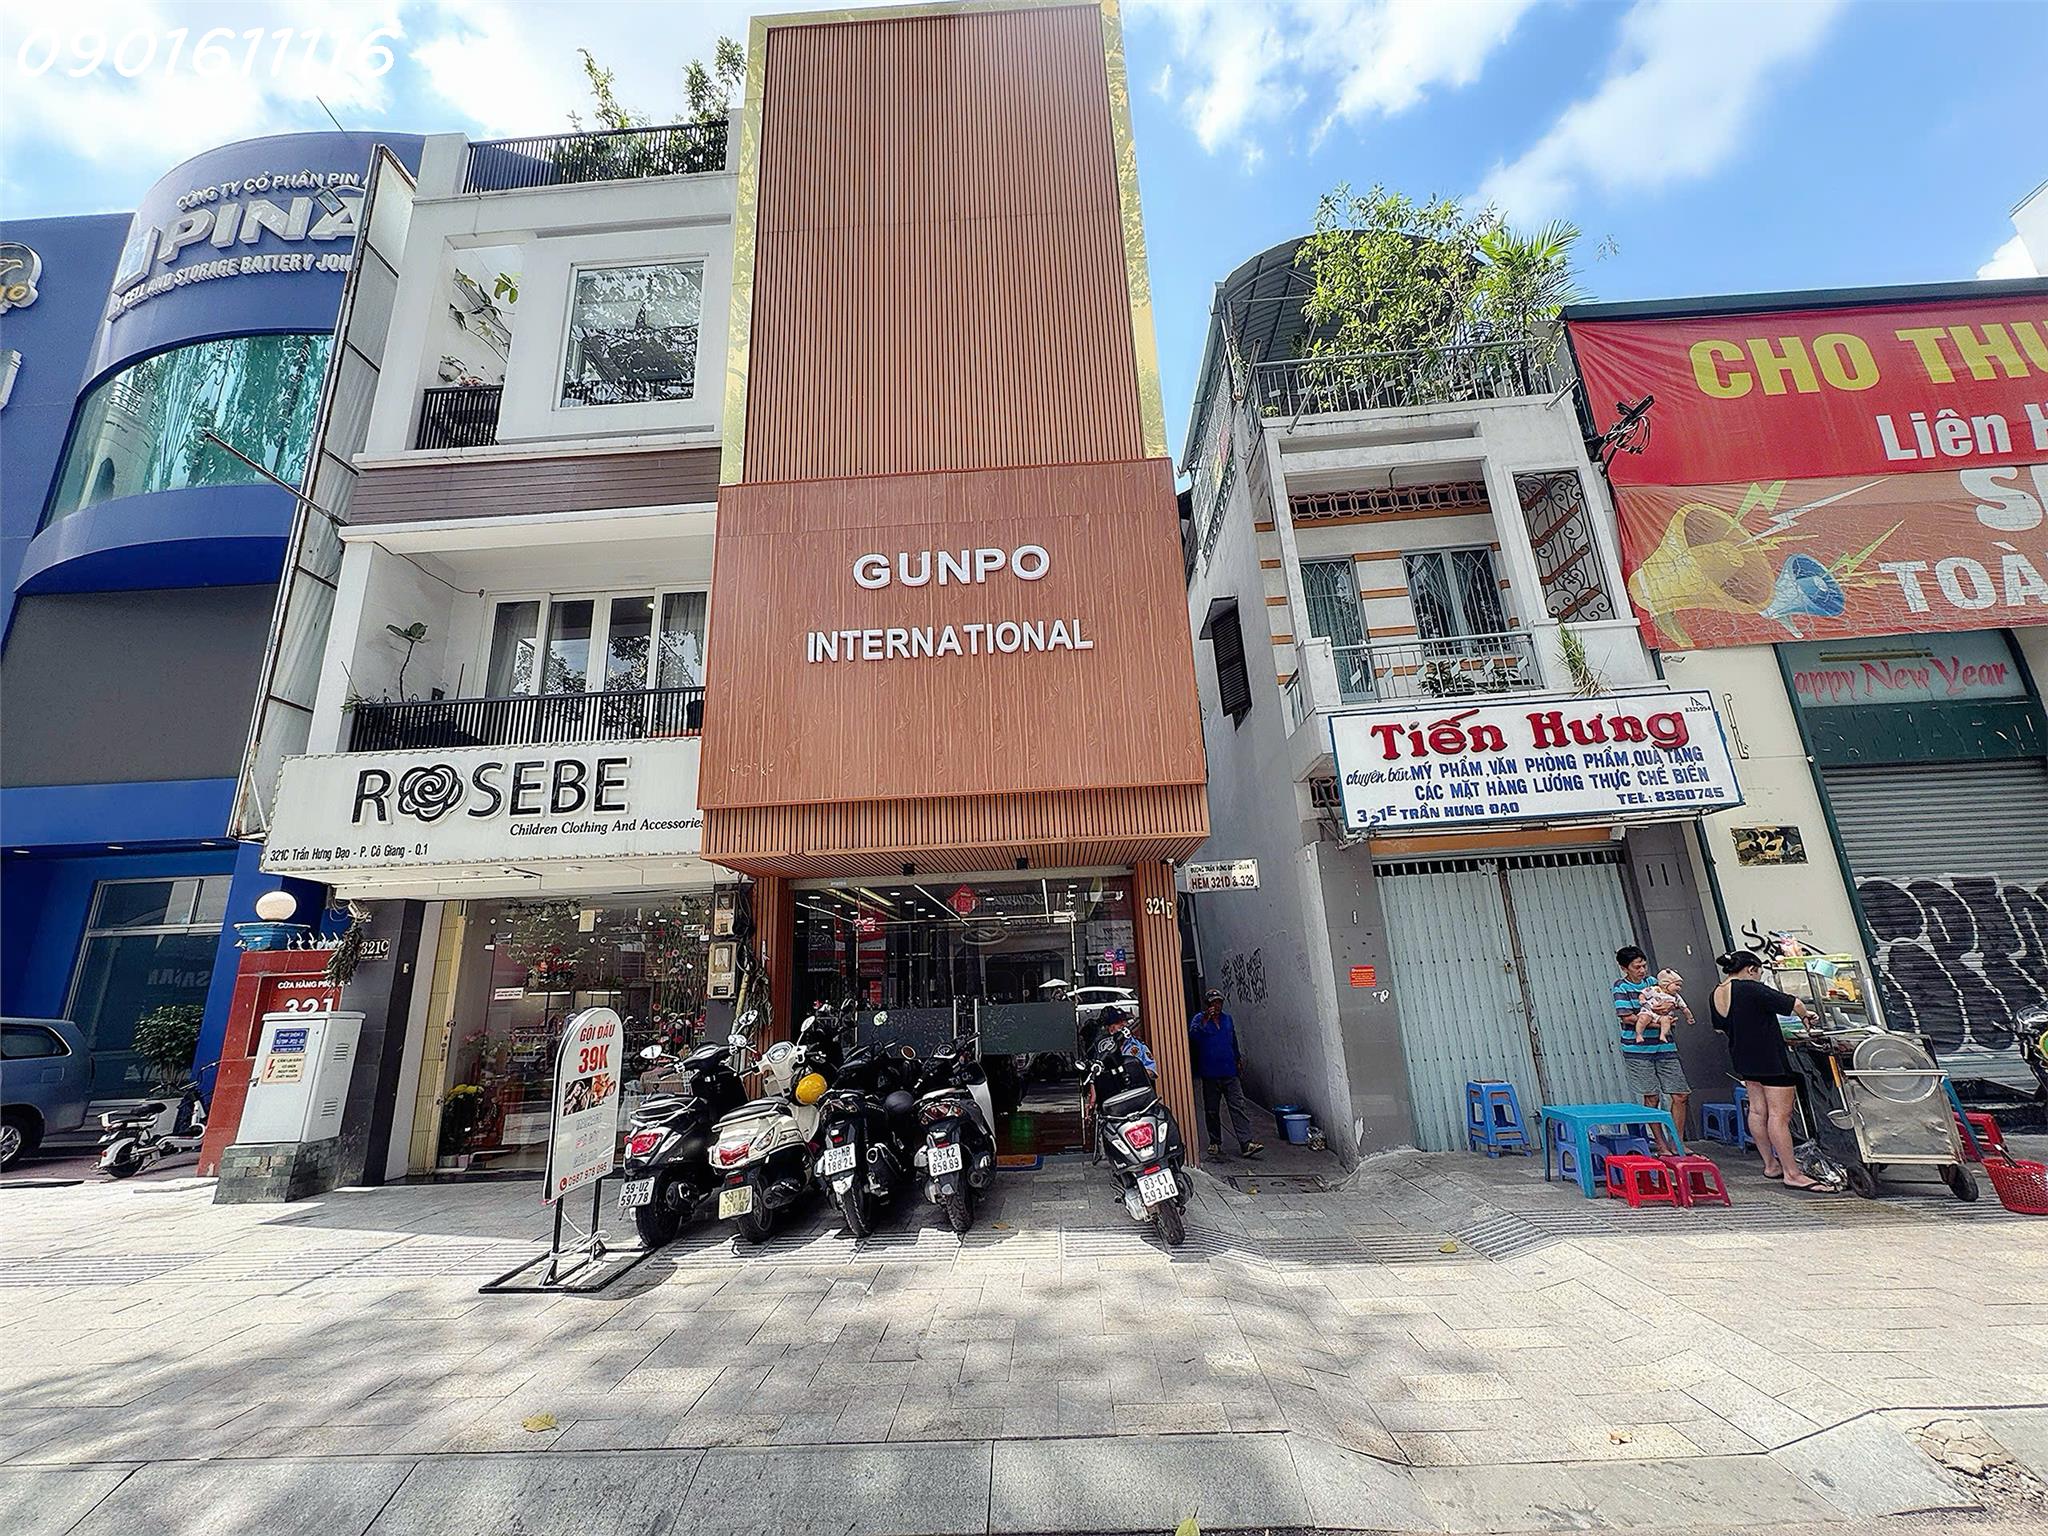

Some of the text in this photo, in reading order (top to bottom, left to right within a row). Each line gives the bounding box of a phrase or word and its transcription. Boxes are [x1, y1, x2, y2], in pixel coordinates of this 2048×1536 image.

[220, 180, 242, 198] TY
[243, 171, 273, 192] CỔ
[327, 172, 359, 186] PIN
[174, 258, 241, 286] STORAGE
[239, 253, 316, 275] BATTERY
[1688, 331, 1881, 399] CHO
[1875, 408, 2013, 461] Liên
[852, 544, 1051, 590] GUNPO
[807, 618, 1094, 663] INTERNATIONAL
[1860, 660, 1930, 698] New
[1930, 655, 2010, 696] Year
[1370, 708, 1690, 761] Tiến Hưng
[1346, 769, 1387, 787] chuyên
[1526, 751, 1576, 774] PHÒNG
[1414, 781, 1444, 801] CÁC
[1450, 779, 1480, 800] MẶT
[1486, 775, 1528, 796] HÀNG
[1589, 769, 1631, 791] THỰC
[1637, 763, 1669, 785] CHẾ
[1672, 761, 1710, 784] BIẾN
[1655, 787, 1725, 801] 8360745
[1400, 803, 1440, 820] TRẦN
[1444, 804, 1485, 817] HƯNG
[1489, 801, 1520, 816] ĐẠO
[509, 823, 558, 837] Children
[561, 820, 609, 836] Clothing
[612, 819, 637, 832] And
[270, 849, 290, 862] 321C
[312, 847, 332, 862] Hưng
[335, 846, 351, 861] Đạo
[359, 845, 368, 858] P.
[383, 844, 406, 859] Giang
[414, 842, 429, 856] Q.1
[1210, 875, 1231, 889] 321D
[1232, 875, 1239, 887] &
[1240, 874, 1255, 887] 329
[360, 939, 390, 955] 321C
[295, 979, 318, 988] HÀNG
[580, 1024, 597, 1044] GỘI
[578, 1044, 610, 1073] 39K
[932, 1147, 956, 1162] 59-K2
[625, 1181, 649, 1194] 59-U2
[1143, 1173, 1168, 1190] 83-C1
[1144, 1183, 1176, 1202] 593.40
